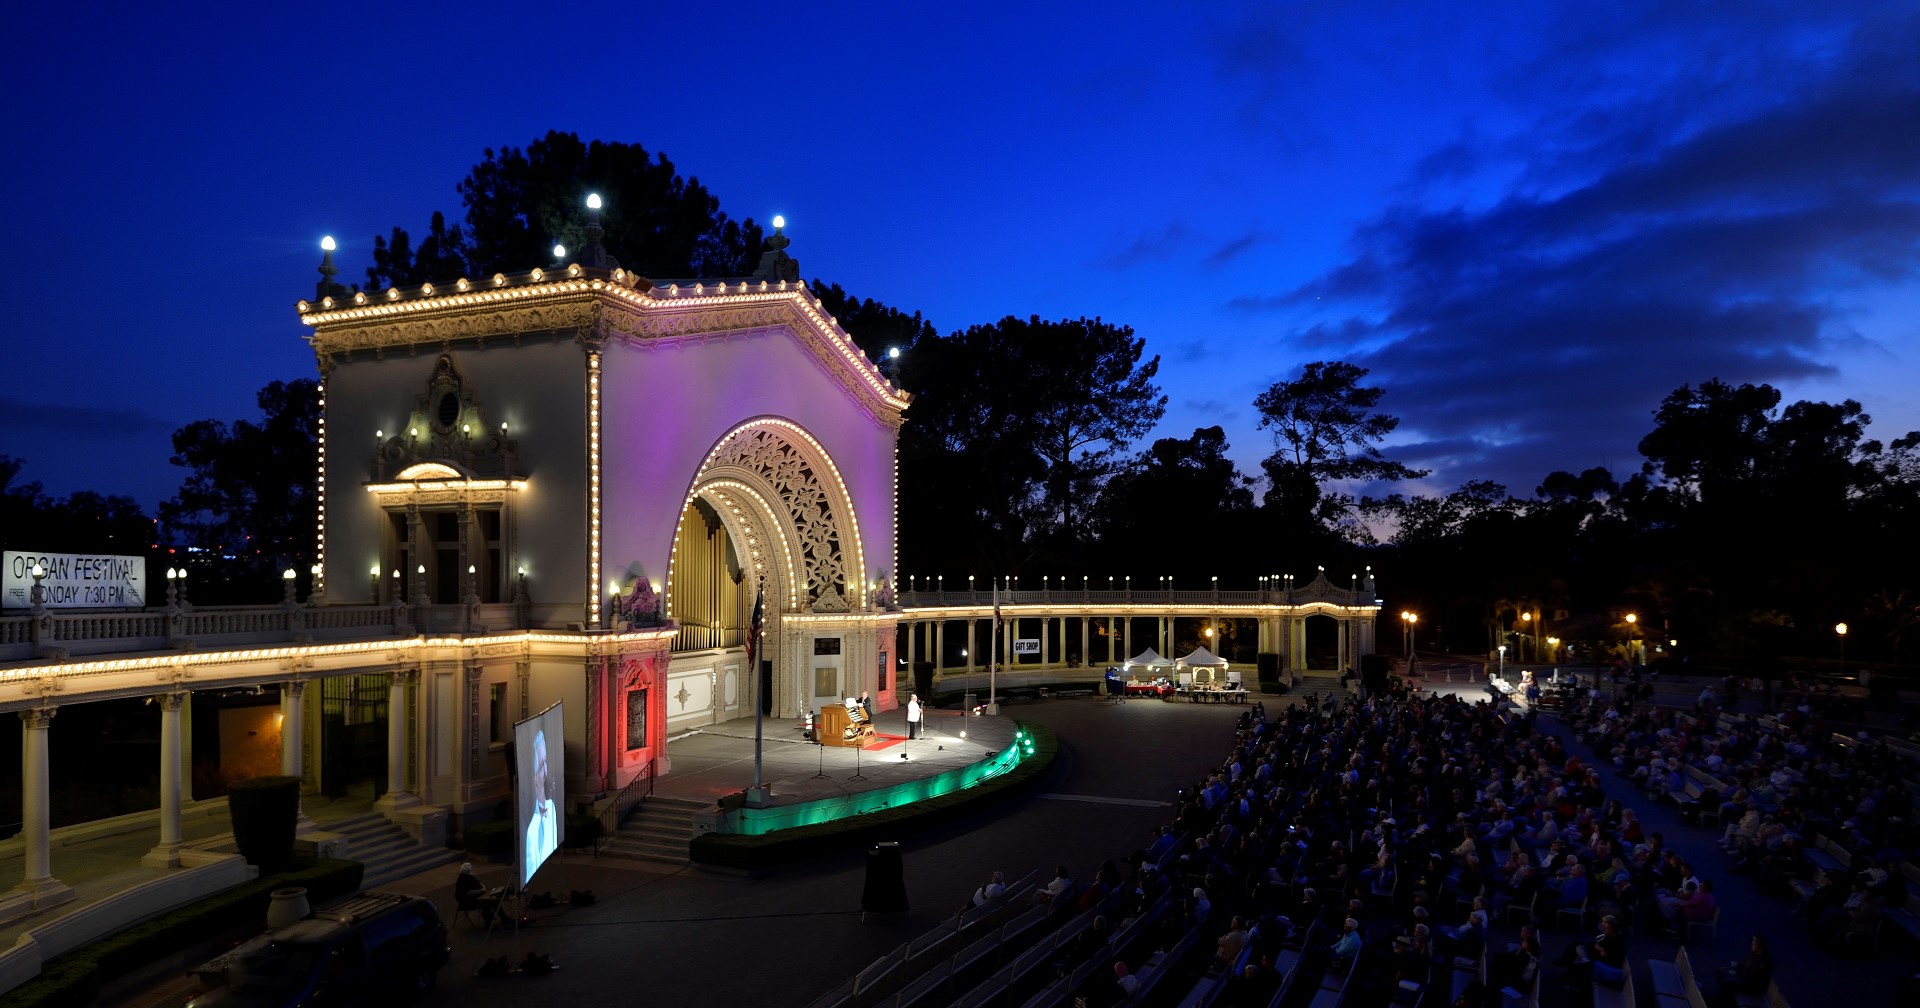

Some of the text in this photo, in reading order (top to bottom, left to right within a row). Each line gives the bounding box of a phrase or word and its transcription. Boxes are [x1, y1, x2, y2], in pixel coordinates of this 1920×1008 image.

[14, 556, 137, 581] ORGAN FESTIVAL
[10, 588, 24, 597] FREE
[85, 586, 106, 603] 7:30
[109, 586, 124, 603] PM
[1015, 641, 1038, 651] GIFT SHOP
